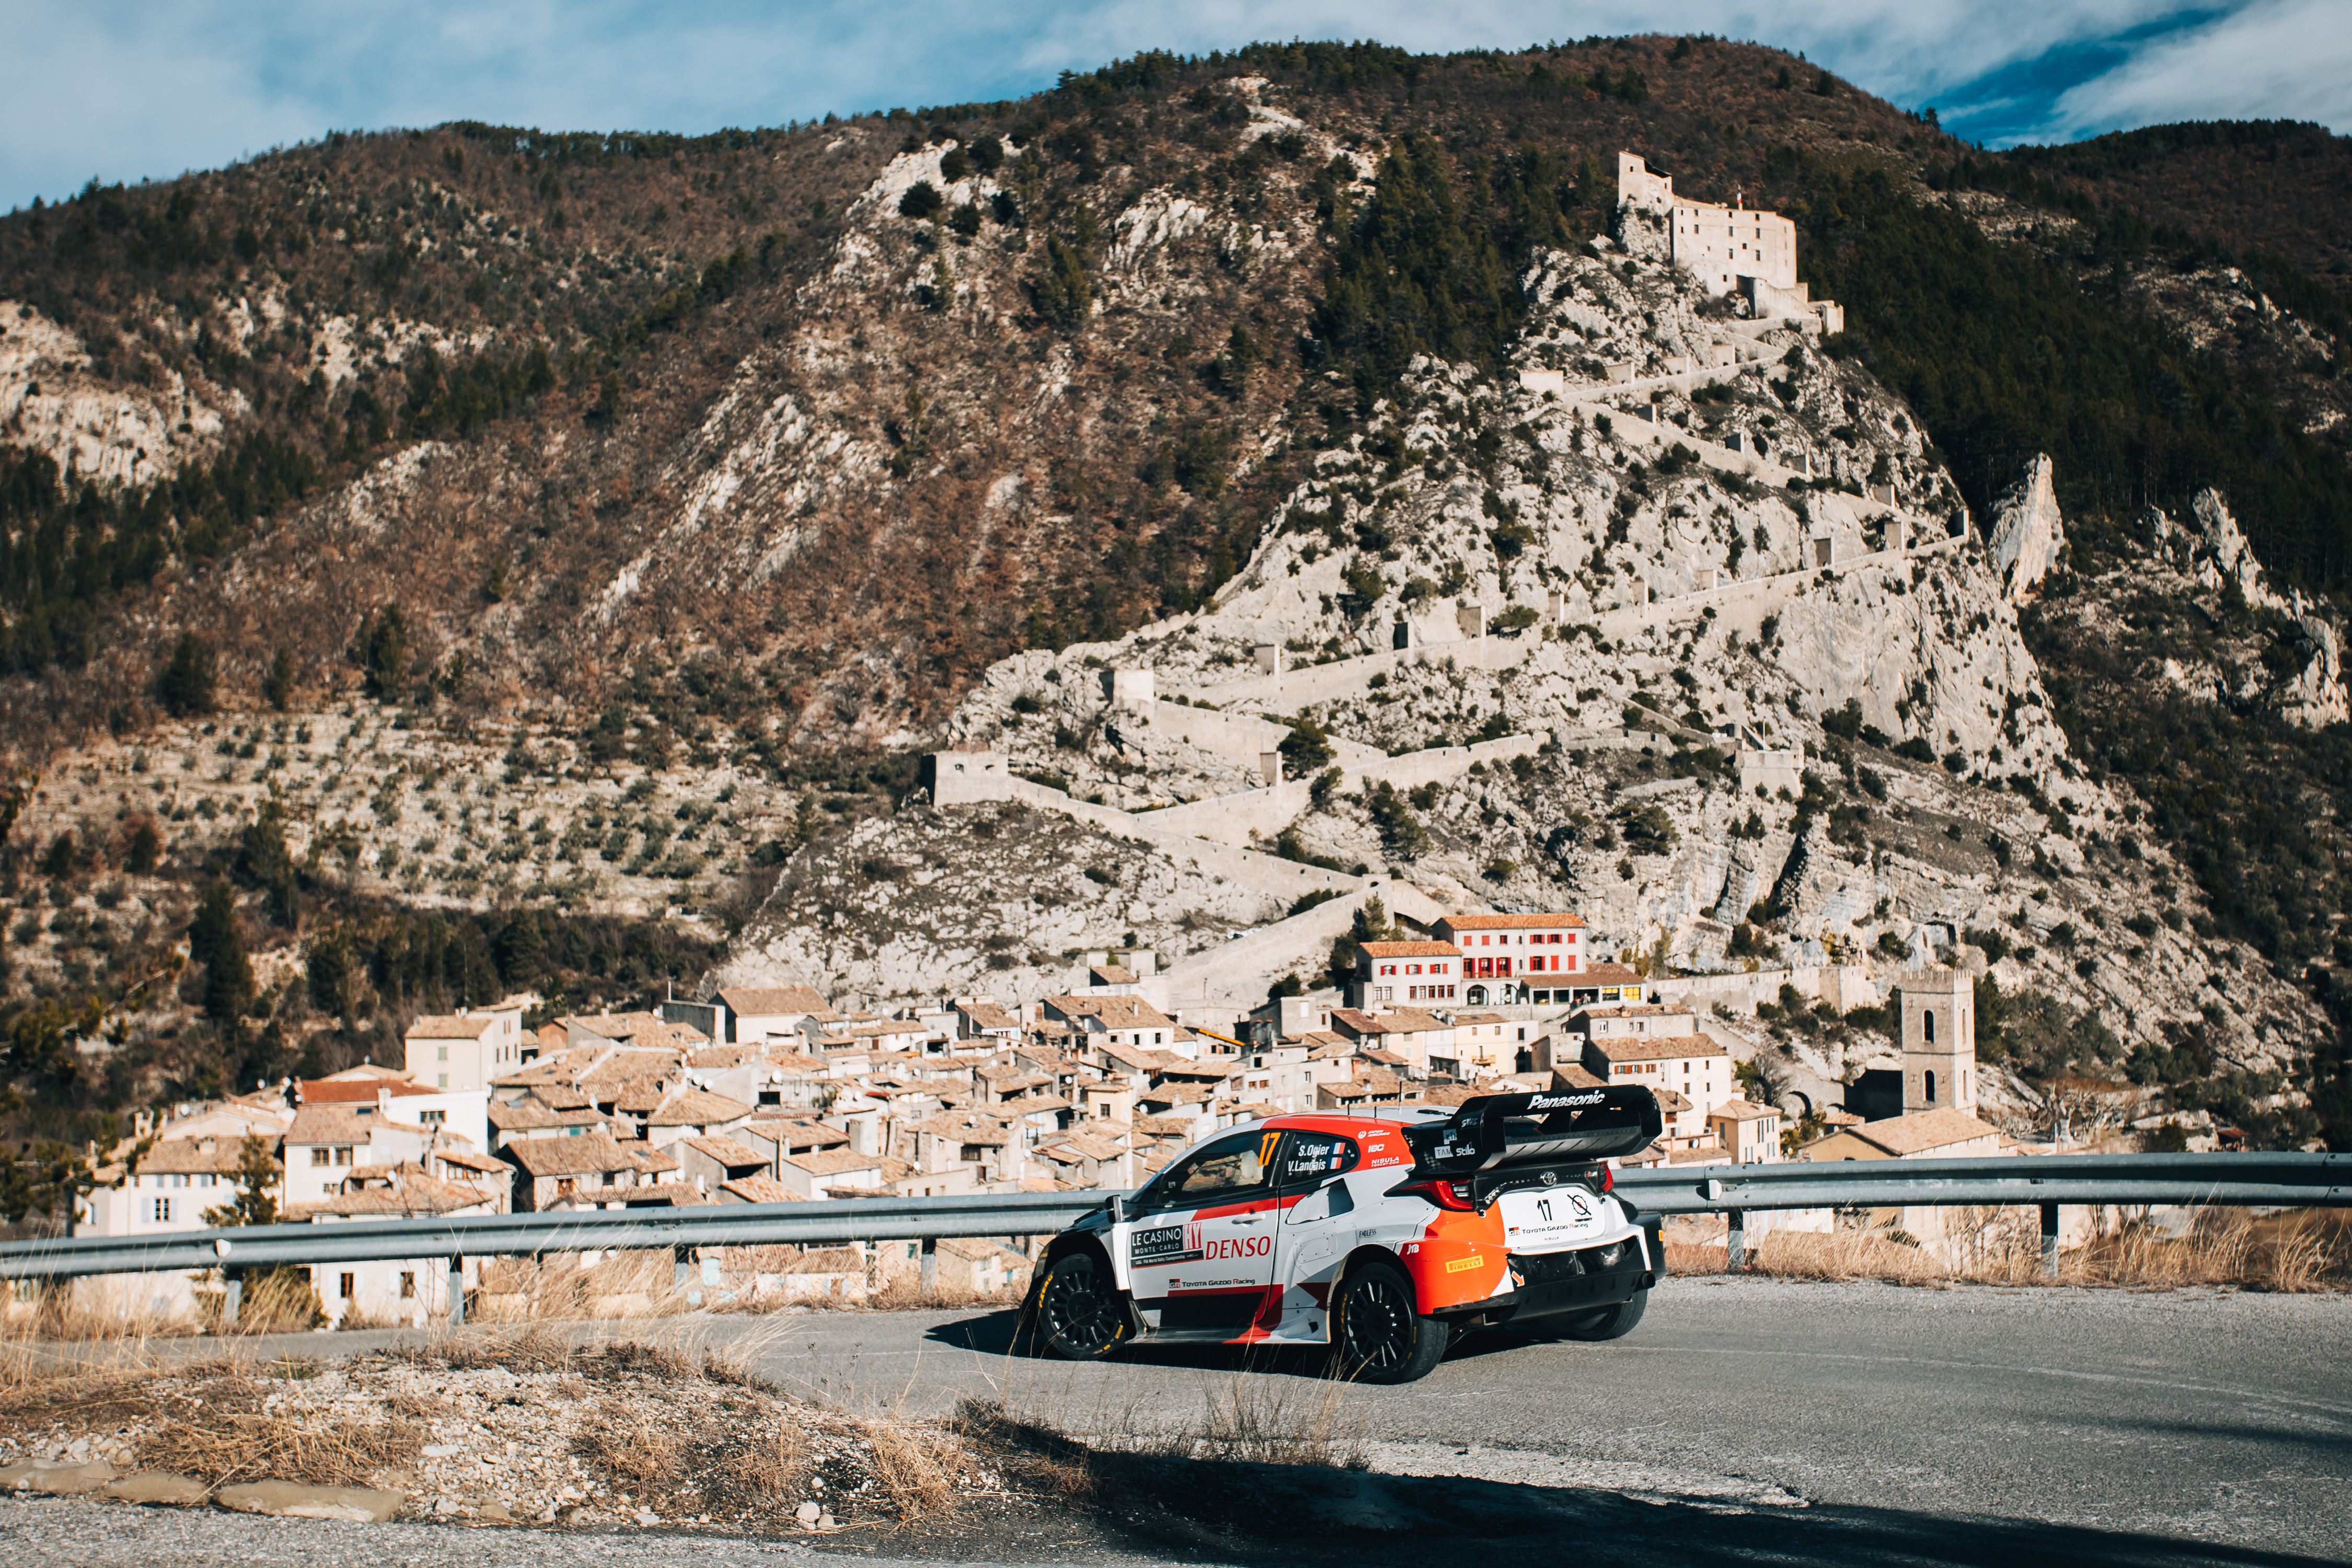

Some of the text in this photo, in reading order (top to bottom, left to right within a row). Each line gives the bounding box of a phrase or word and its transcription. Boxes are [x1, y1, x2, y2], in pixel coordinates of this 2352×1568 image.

[1527, 1090, 1605, 1110] Panasonic
[1258, 1132, 1281, 1166] 17
[1456, 1143, 1475, 1156] Stilo
[1371, 1156, 1400, 1165] NISULA
[1537, 1199, 1552, 1221] 17
[1132, 1228, 1182, 1246] LE CASINO
[1184, 1222, 1202, 1250] HY
[1359, 1228, 1377, 1238] ENDLESS
[1205, 1236, 1271, 1260] DENSO
[1406, 1243, 1420, 1255] JTB
[1449, 1257, 1481, 1271] PIRELLI
